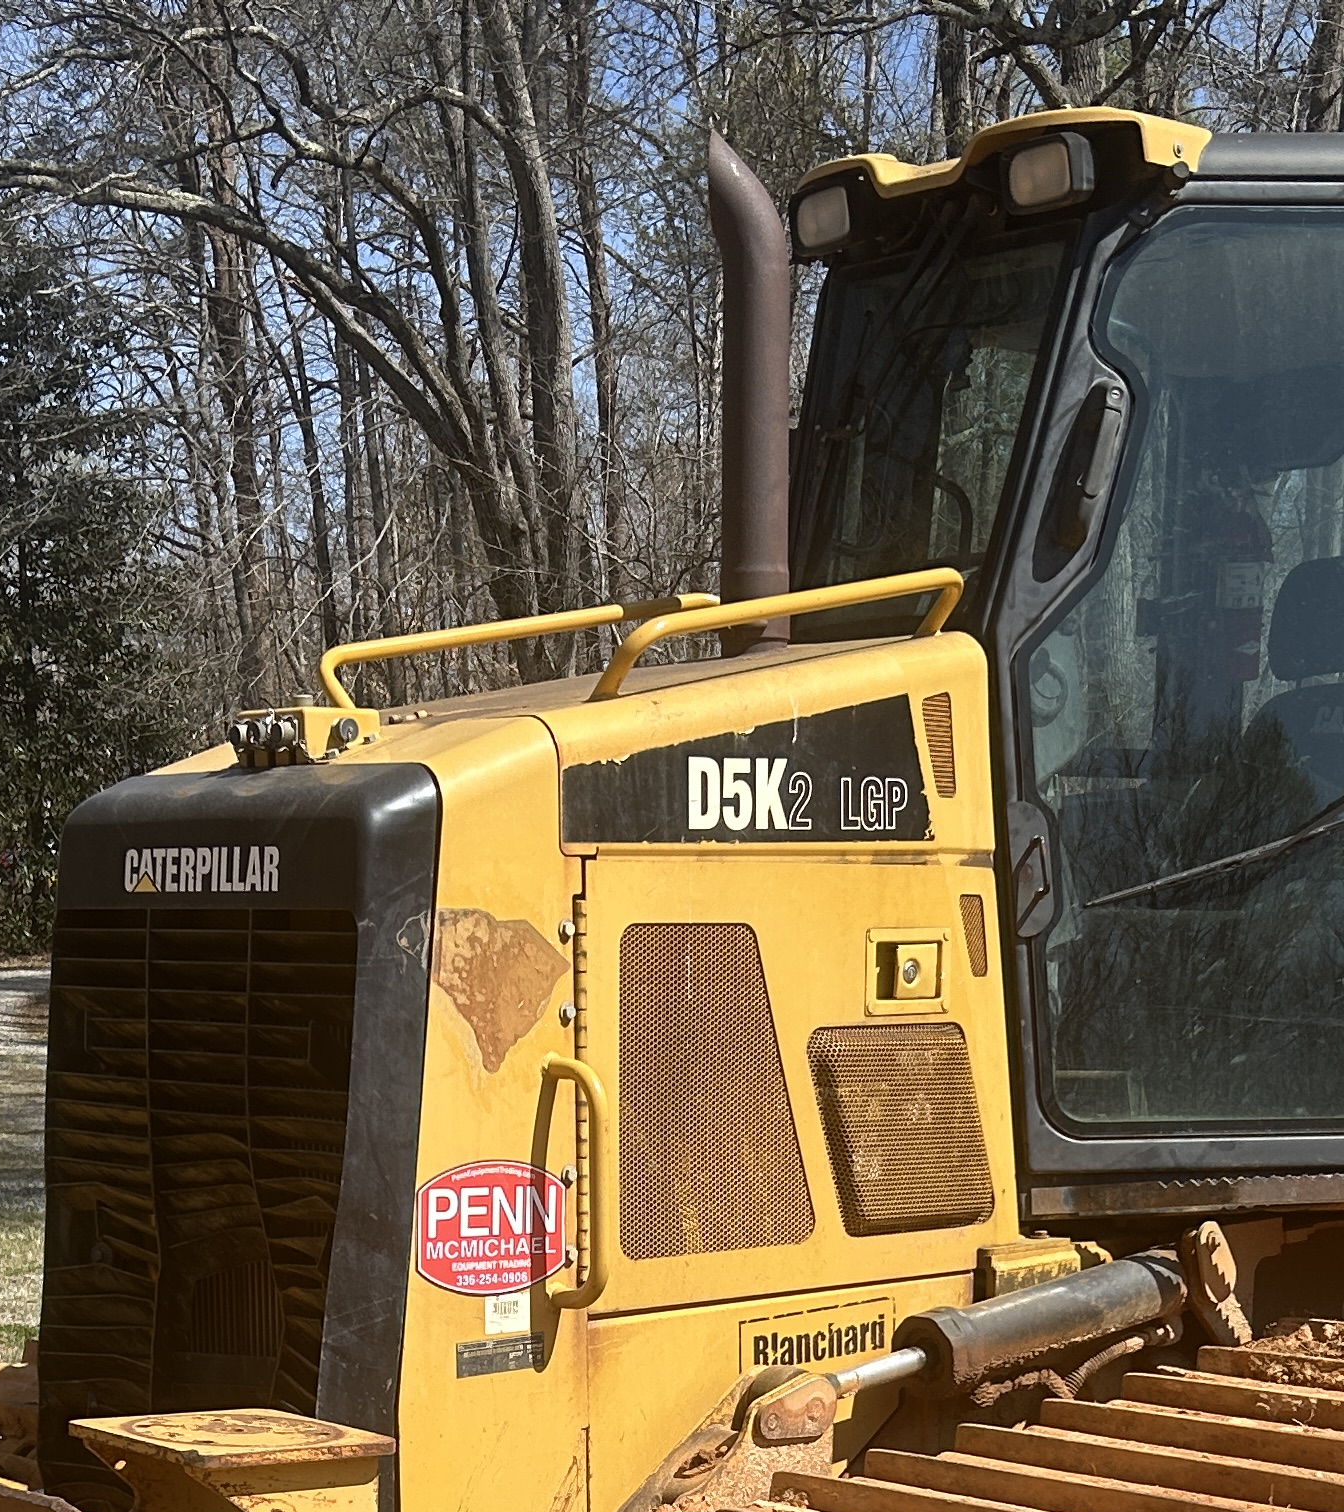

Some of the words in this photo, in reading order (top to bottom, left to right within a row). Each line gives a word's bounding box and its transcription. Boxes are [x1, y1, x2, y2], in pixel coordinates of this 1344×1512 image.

[840, 775, 908, 831] LGP
[123, 845, 281, 893] CATERPILLAR
[427, 1183, 557, 1239] PENN
[426, 1236, 557, 1260] MCMICHAEL
[451, 1260, 498, 1272] EQUIPMENT
[498, 1258, 532, 1270] TRADING
[456, 1271, 528, 1286] 336-254-0906
[753, 1313, 886, 1367] Blanchard
